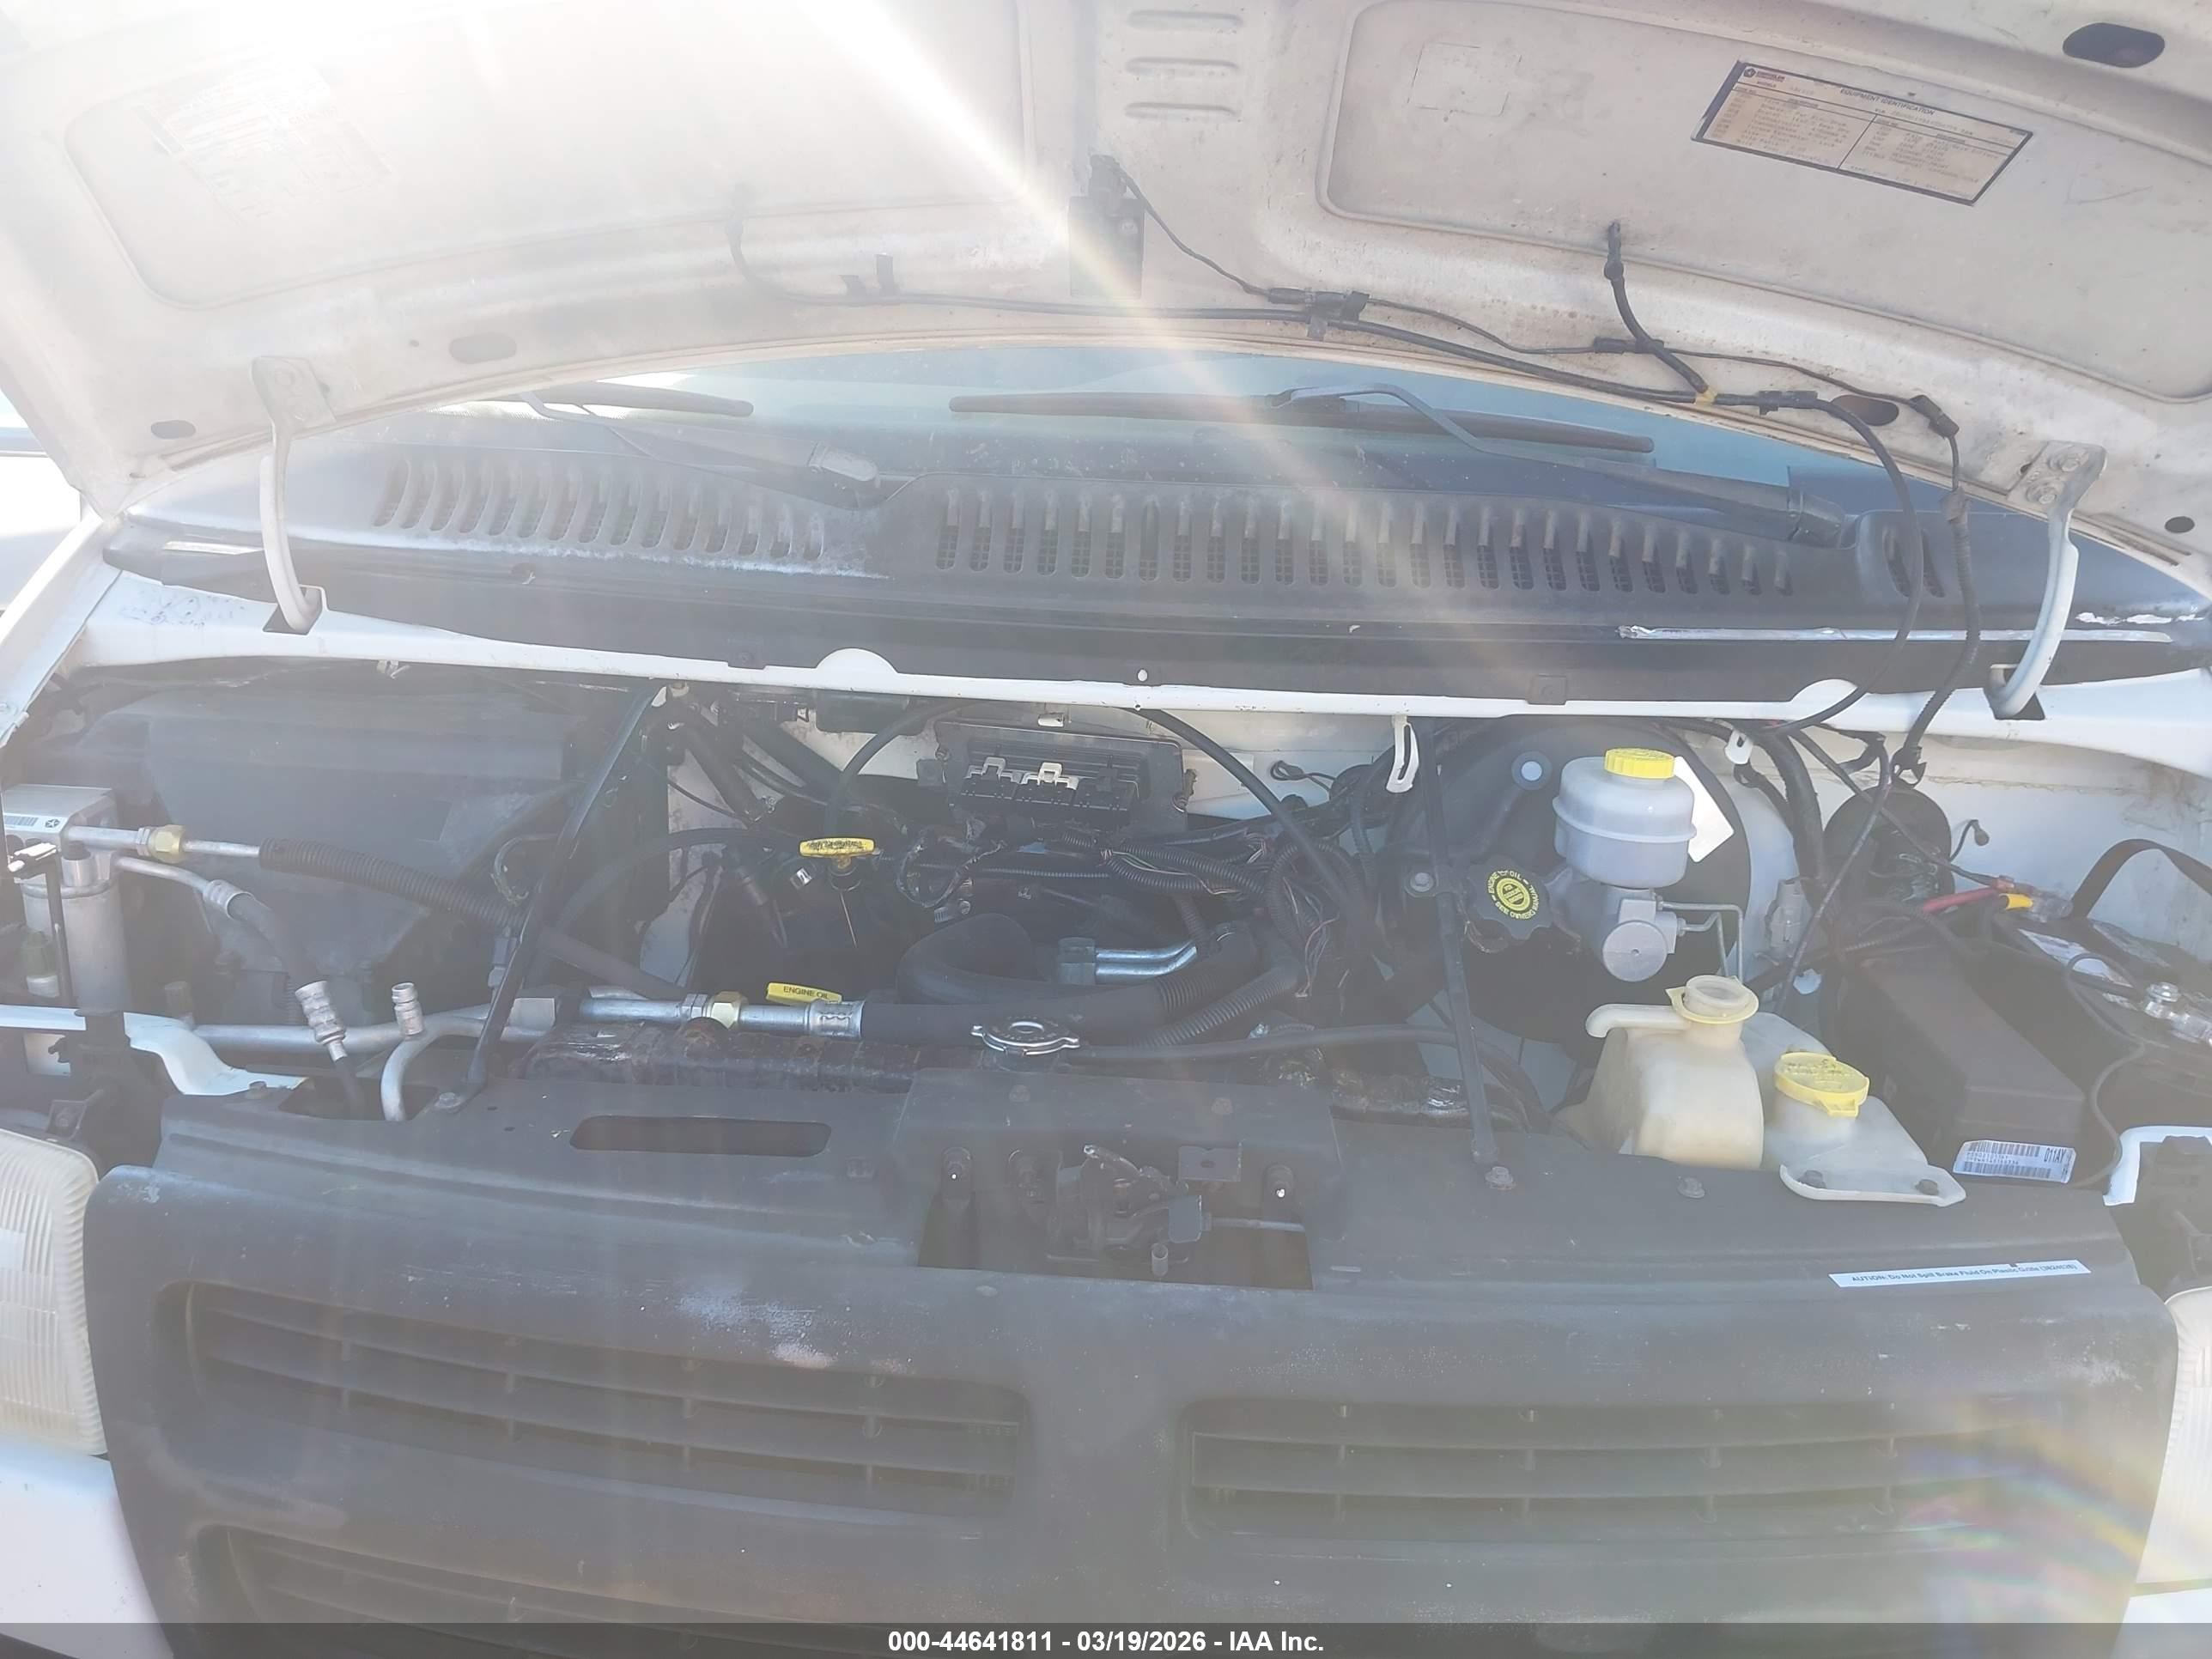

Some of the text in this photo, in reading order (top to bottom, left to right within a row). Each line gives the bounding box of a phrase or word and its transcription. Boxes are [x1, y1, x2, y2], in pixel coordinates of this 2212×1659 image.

[1840, 88, 1936, 115] EQUIPMENT IDENTIFICATION
[1510, 871, 1522, 880] OIL
[783, 986, 814, 997] ENGINE
